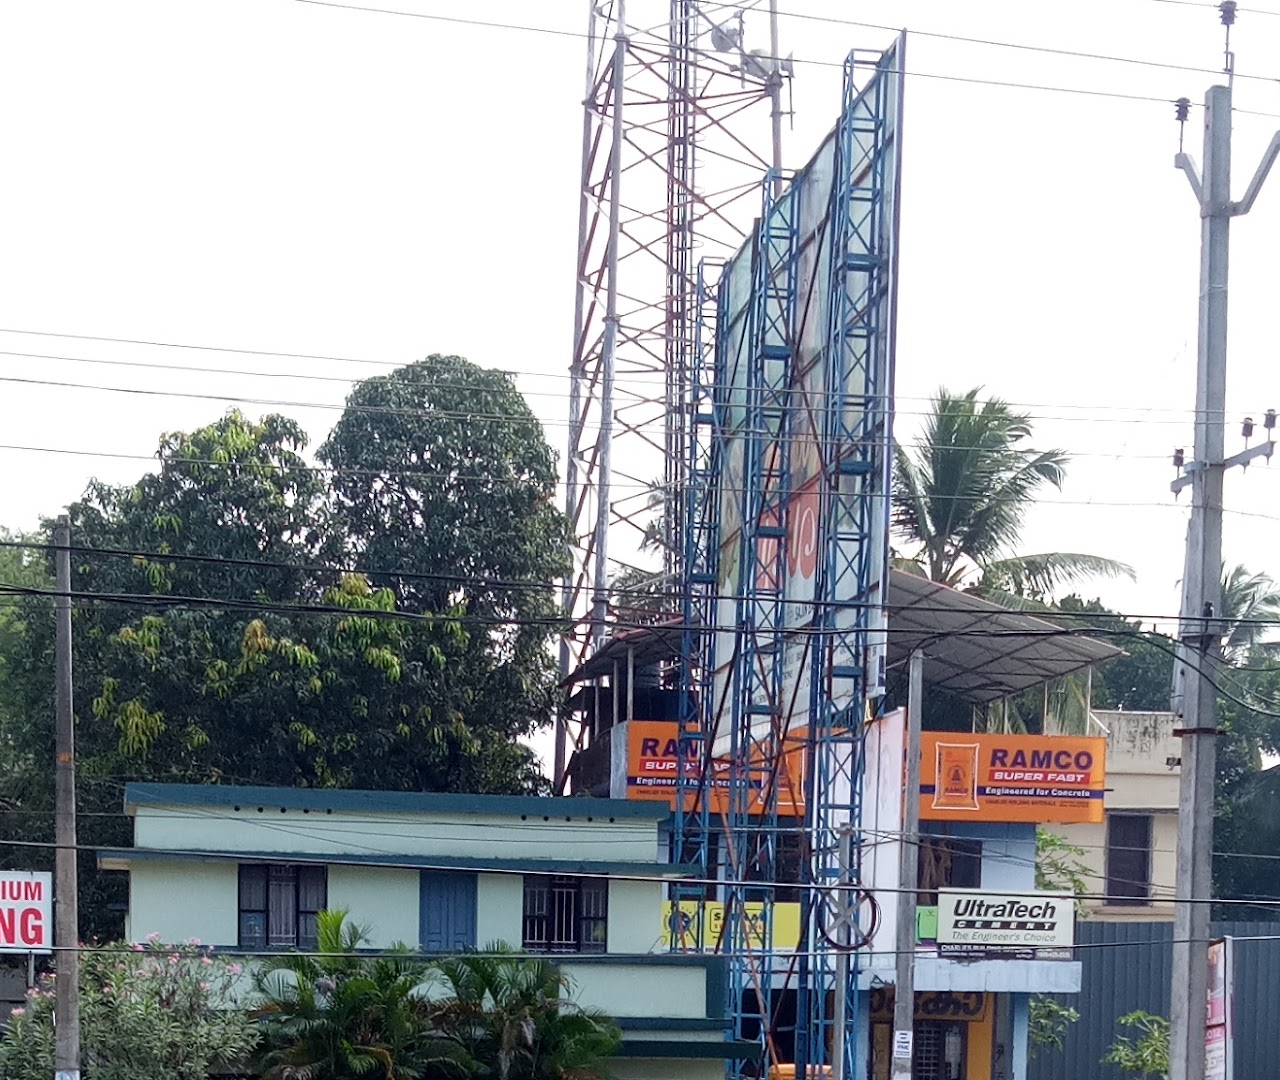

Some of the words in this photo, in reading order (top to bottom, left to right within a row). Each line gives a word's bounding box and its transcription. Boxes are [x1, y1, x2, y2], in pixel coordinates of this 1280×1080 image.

[990, 749, 1093, 770] RAMCO
[994, 772, 1044, 781] SUPER
[1047, 773, 1085, 782] FAST
[985, 786, 1035, 796] Engineered
[1036, 787, 1049, 796] for
[1051, 788, 1091, 797] Concrete
[953, 899, 1056, 919] UltraTech
[957, 920, 1053, 930] CEMENT
[952, 931, 969, 940] The
[972, 931, 1020, 942] Engineer's
[1023, 933, 1056, 942] Choice
